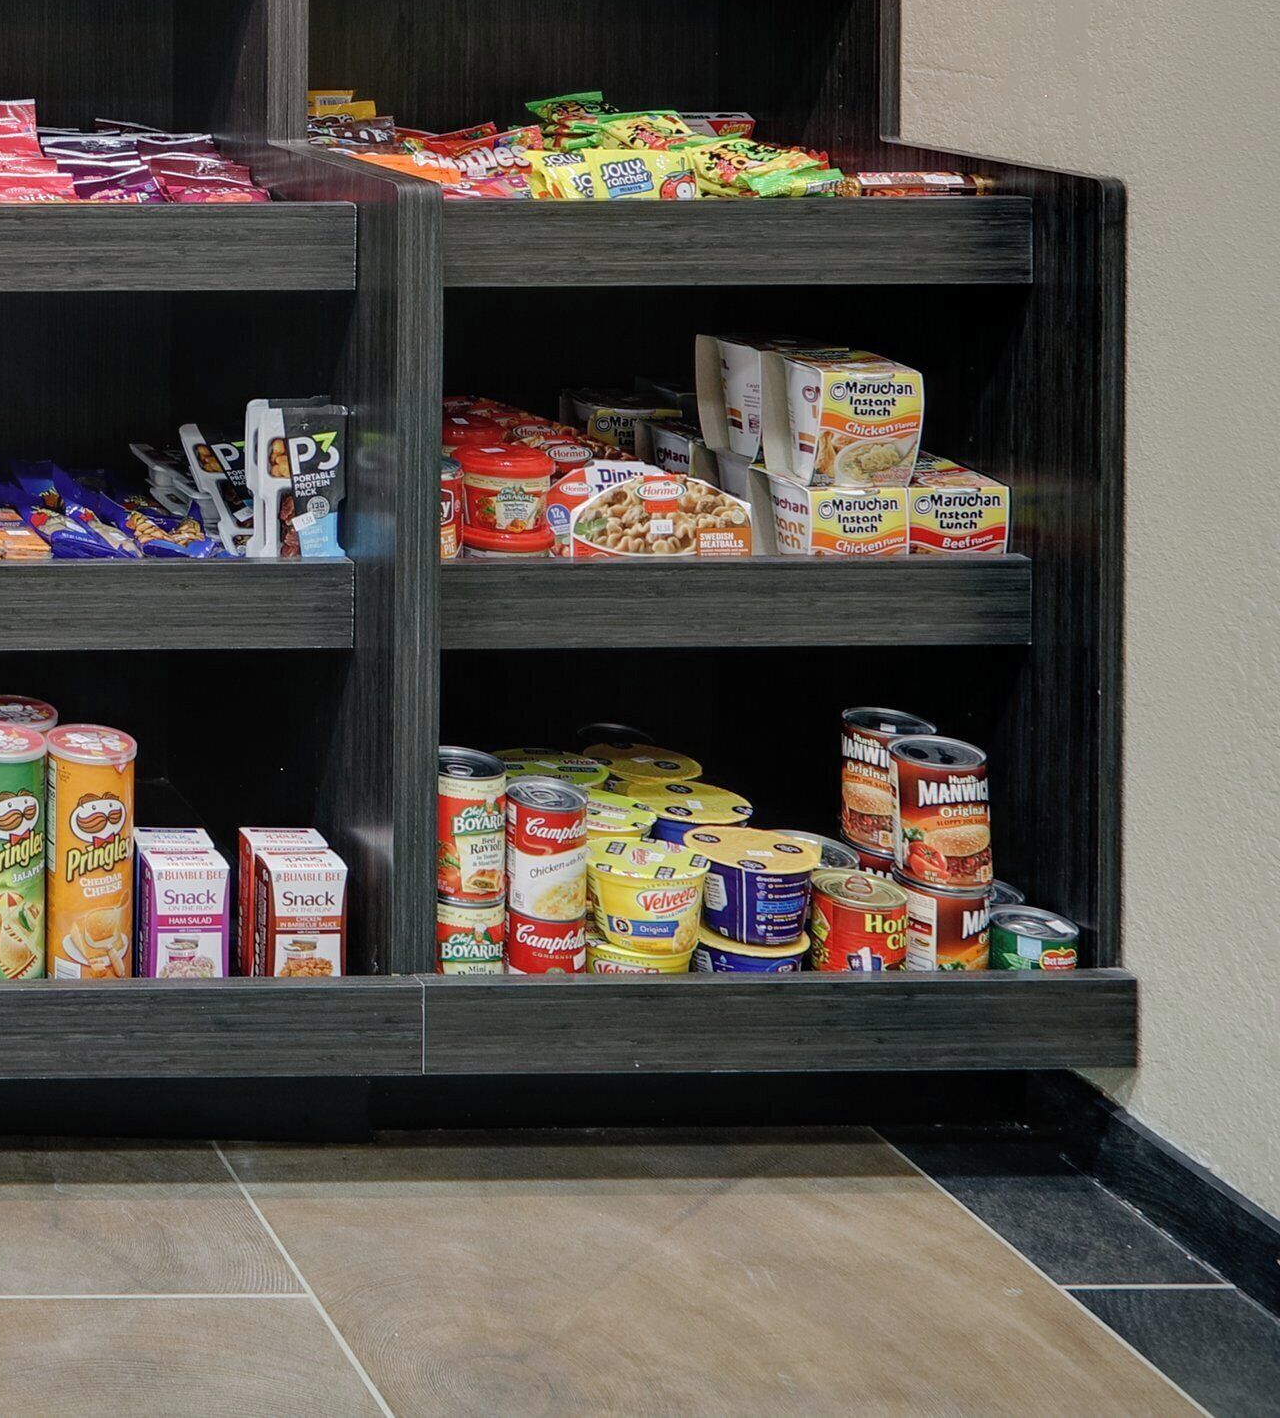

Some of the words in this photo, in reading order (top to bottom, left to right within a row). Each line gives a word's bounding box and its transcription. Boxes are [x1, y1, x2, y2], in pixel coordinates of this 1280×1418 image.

[601, 159, 646, 181] JOLLY
[606, 171, 651, 187] rancher
[846, 381, 913, 396] Maruchan
[850, 397, 896, 407] Instant
[854, 407, 891, 416] Lunch
[845, 421, 894, 436] Chicken
[895, 421, 918, 430] Flavor
[289, 431, 340, 475] P3
[552, 449, 589, 459] Hormel
[293, 471, 336, 483] PORTABLE
[294, 479, 330, 491] PROTEIN
[643, 484, 683, 496] Hormel
[295, 489, 318, 498] PACK
[833, 499, 899, 511] Maruchan
[838, 514, 883, 523] Instant
[940, 520, 977, 530] Lunch
[699, 532, 734, 541] SWEDISH
[942, 536, 971, 549] Beef
[699, 539, 744, 548] MEATBALLS
[835, 539, 883, 554] Chicken
[883, 536, 905, 546] Flavor
[948, 775, 977, 784] Hunt's
[461, 806, 484, 818] Chef
[940, 807, 985, 817] Original
[66, 835, 131, 883] Pringles
[164, 871, 204, 881] BUMBLE
[206, 871, 224, 880] BEE
[529, 862, 564, 879] Chicken
[79, 872, 122, 888] CHEDDAR
[83, 883, 122, 898] CHEESE
[164, 889, 216, 905] Snack
[282, 891, 335, 907] Snack
[640, 889, 697, 912] Velveeta
[169, 917, 186, 925] HAM
[468, 965, 487, 973] Mini
